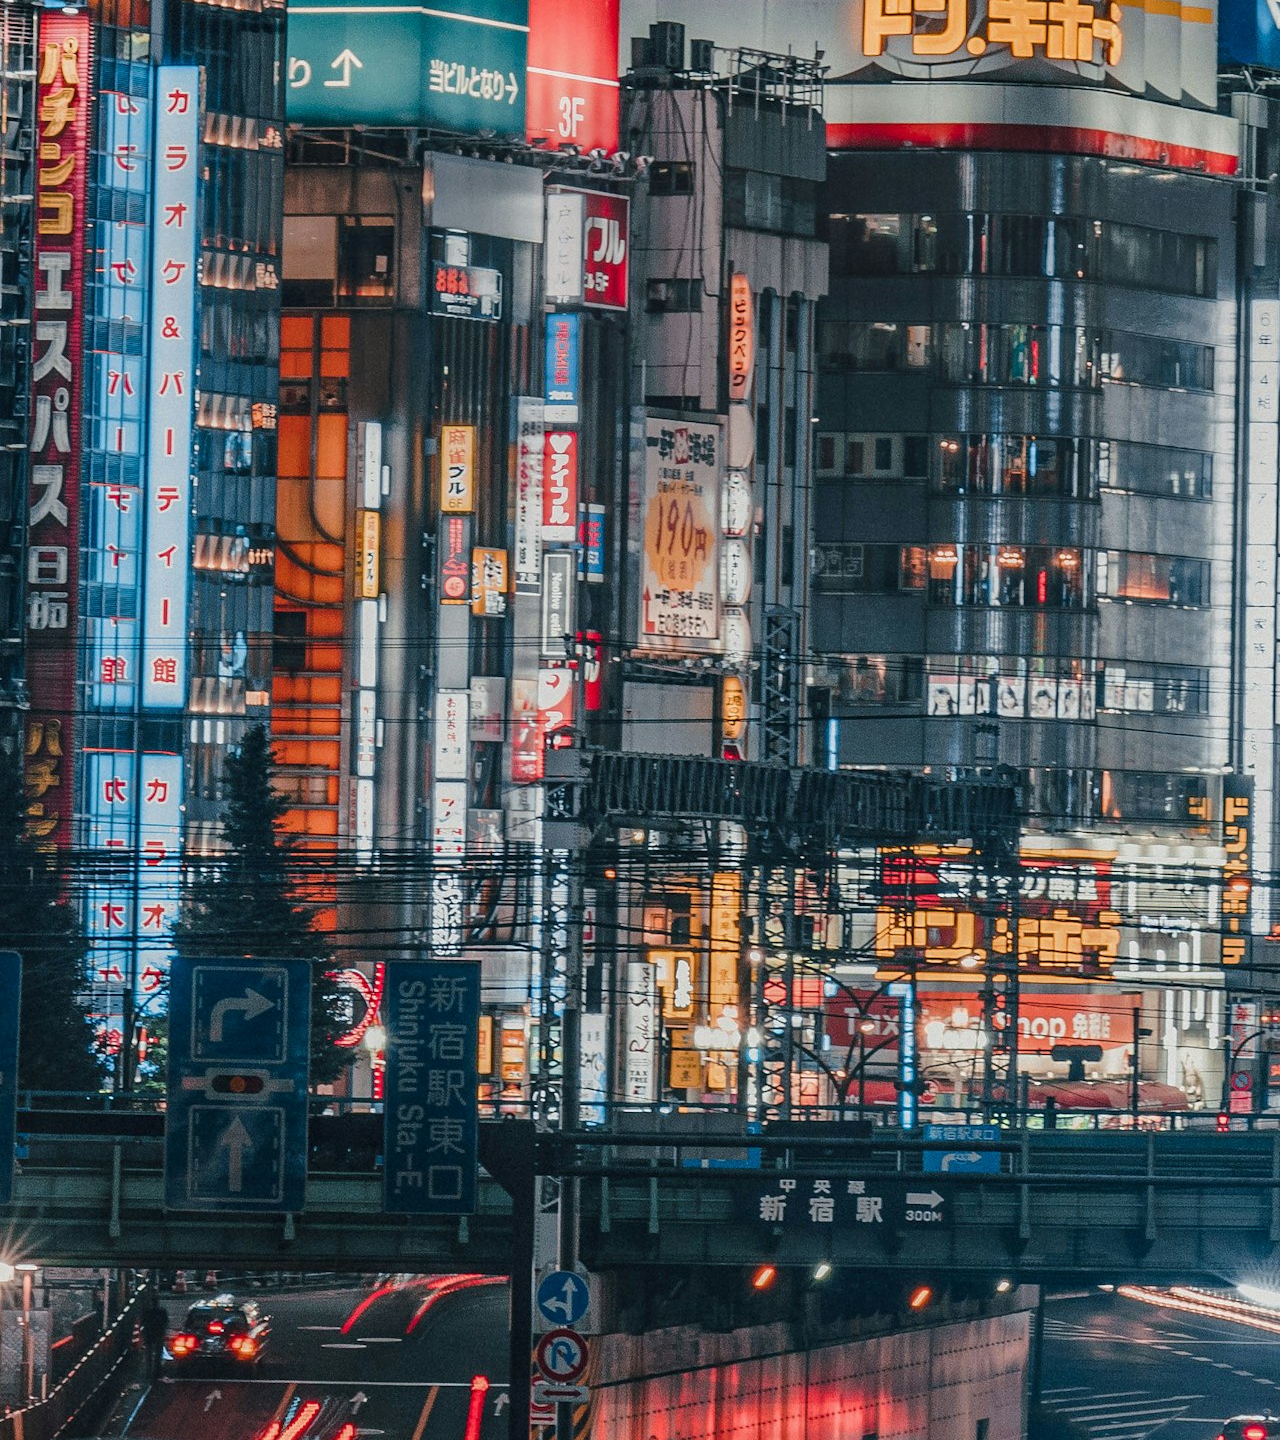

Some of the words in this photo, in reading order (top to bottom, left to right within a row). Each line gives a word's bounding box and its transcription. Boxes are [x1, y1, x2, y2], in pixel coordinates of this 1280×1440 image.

[38, 37, 81, 236] パチンコ
[558, 96, 587, 136] 3F
[554, 321, 570, 385] PROMISE
[28, 251, 73, 527] エスパス
[549, 453, 571, 524] アイフル
[397, 980, 426, 1099] Shinjuku
[427, 975, 468, 1201] 新宿駅東口
[928, 1125, 995, 1142] 新宿駅東口
[759, 1195, 883, 1223] 新宿駅
[905, 1210, 942, 1222] 300M
